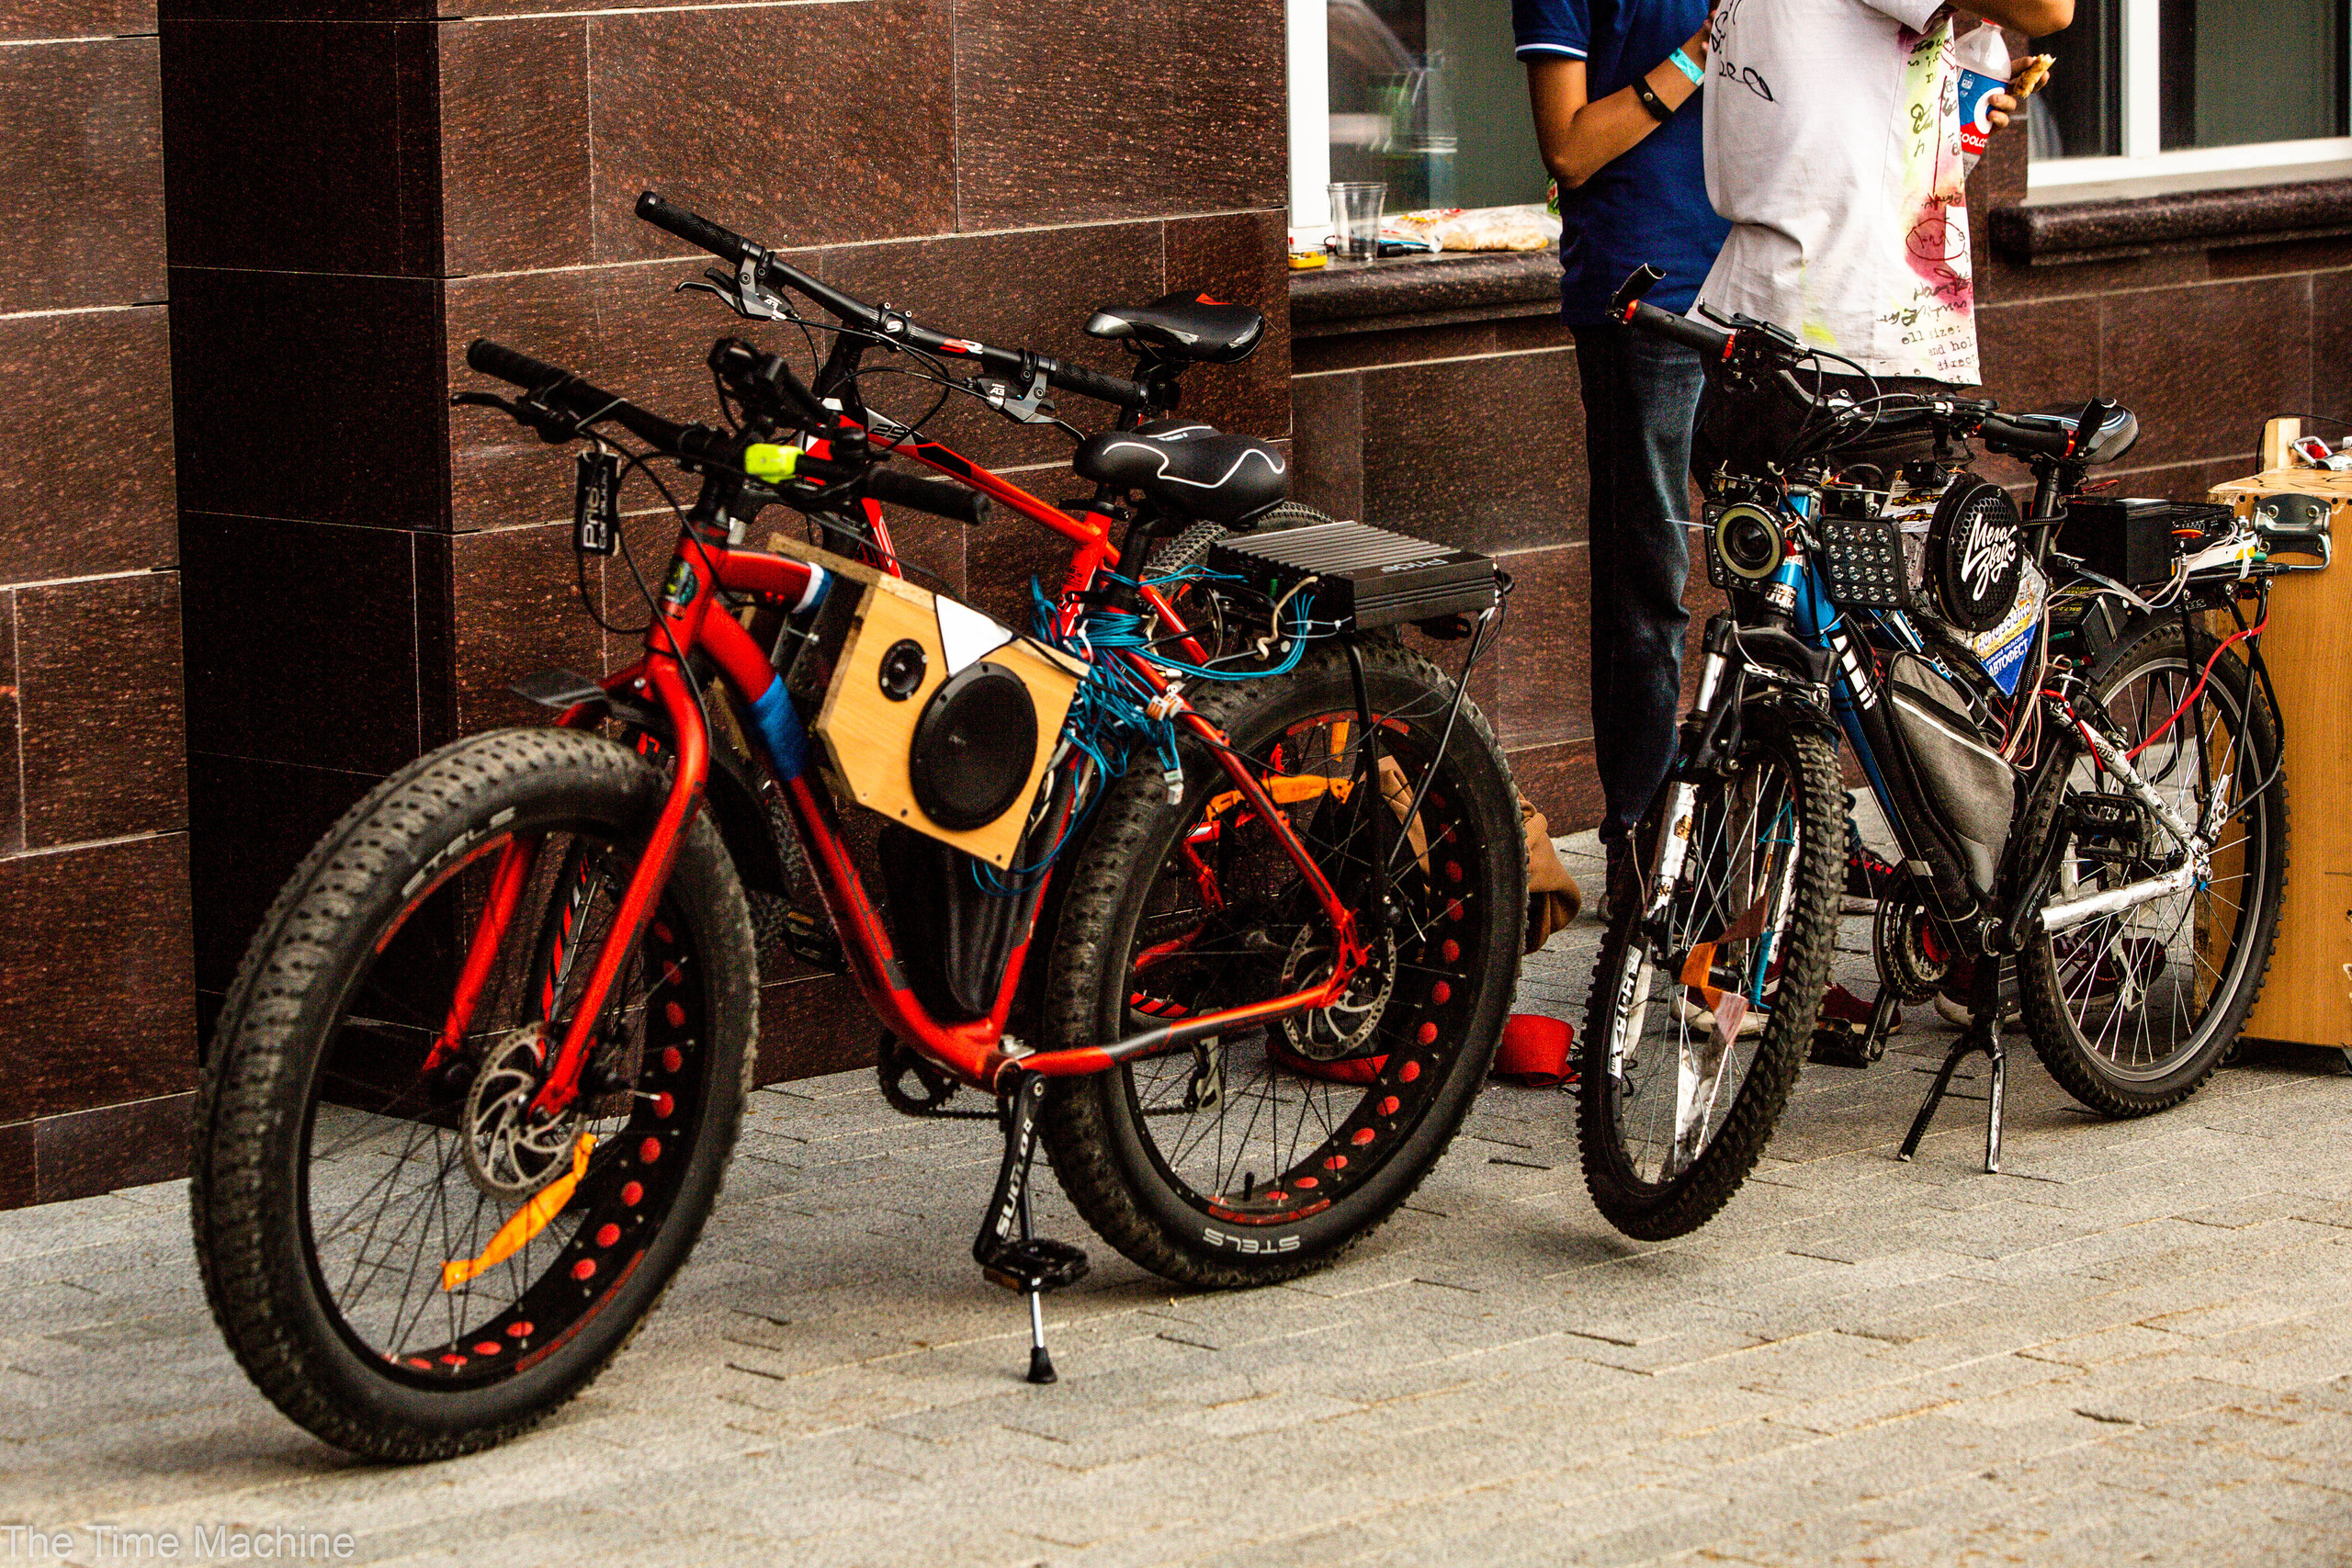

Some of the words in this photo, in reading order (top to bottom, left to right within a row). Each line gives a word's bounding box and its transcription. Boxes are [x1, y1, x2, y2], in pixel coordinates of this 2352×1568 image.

[1977, 603, 2031, 652] AUTOSOUND
[1988, 638, 2029, 676] АВТОФЕСТ
[1203, 1227, 1300, 1254] STELS
